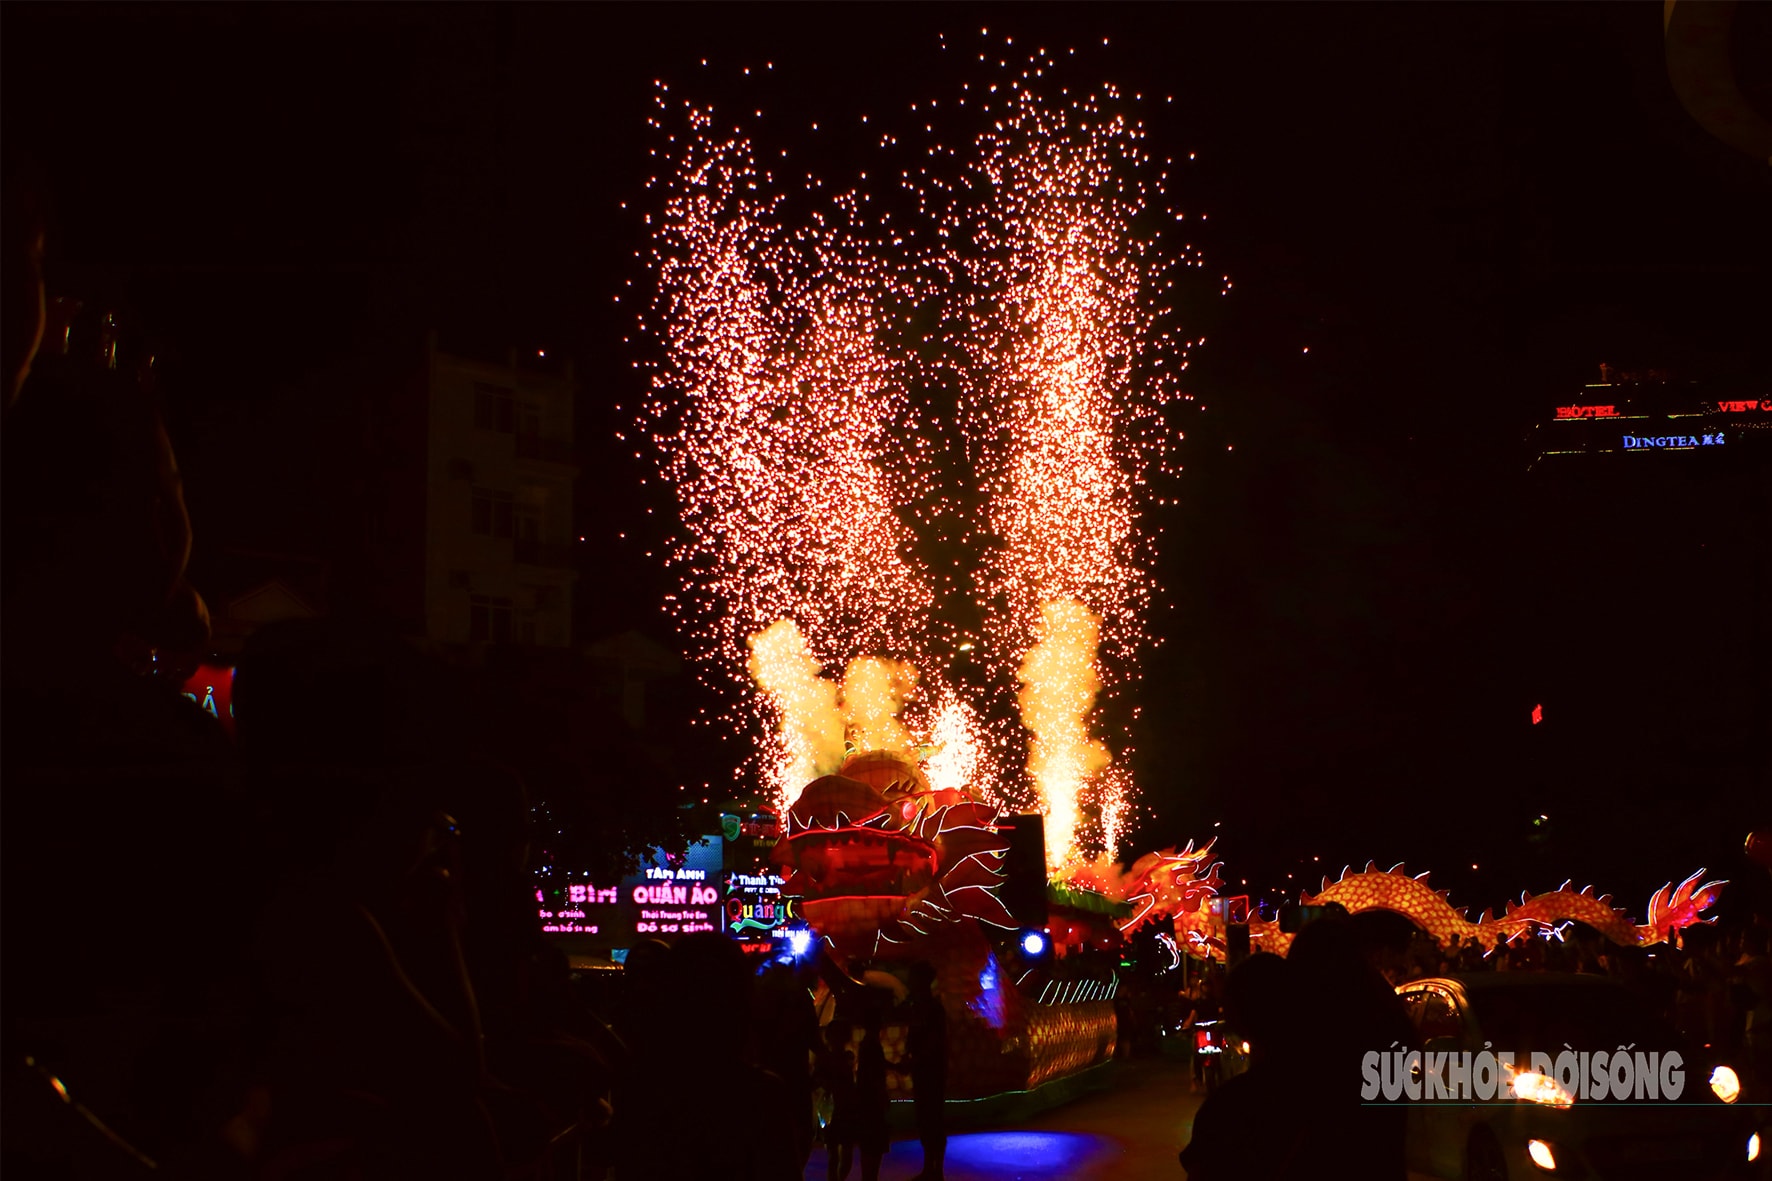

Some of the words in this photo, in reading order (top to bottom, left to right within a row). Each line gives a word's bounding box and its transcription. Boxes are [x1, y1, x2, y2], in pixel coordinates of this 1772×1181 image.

[1718, 400, 1758, 413] VIEW
[1622, 435, 1700, 448] DINGTEA
[738, 874, 767, 886] Thanh
